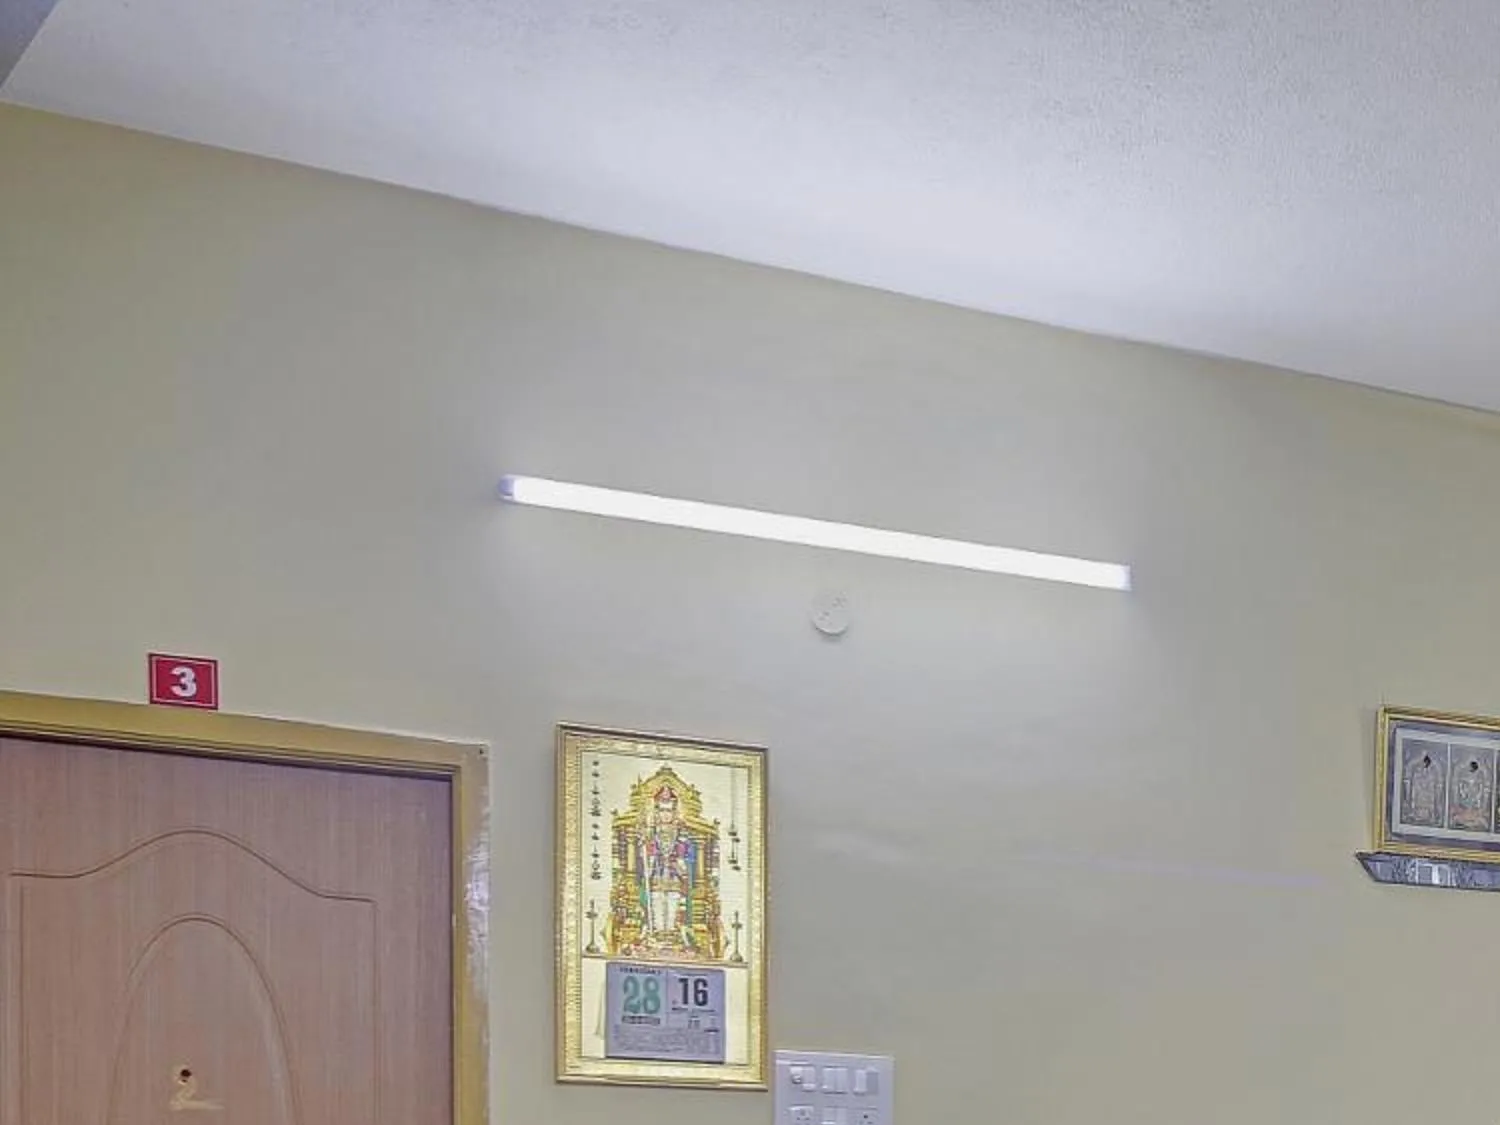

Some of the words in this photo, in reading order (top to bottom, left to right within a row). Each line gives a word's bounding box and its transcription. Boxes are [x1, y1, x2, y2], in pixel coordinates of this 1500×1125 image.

[170, 666, 197, 697] 3
[623, 975, 661, 1014] 28
[678, 977, 709, 1006] 16
